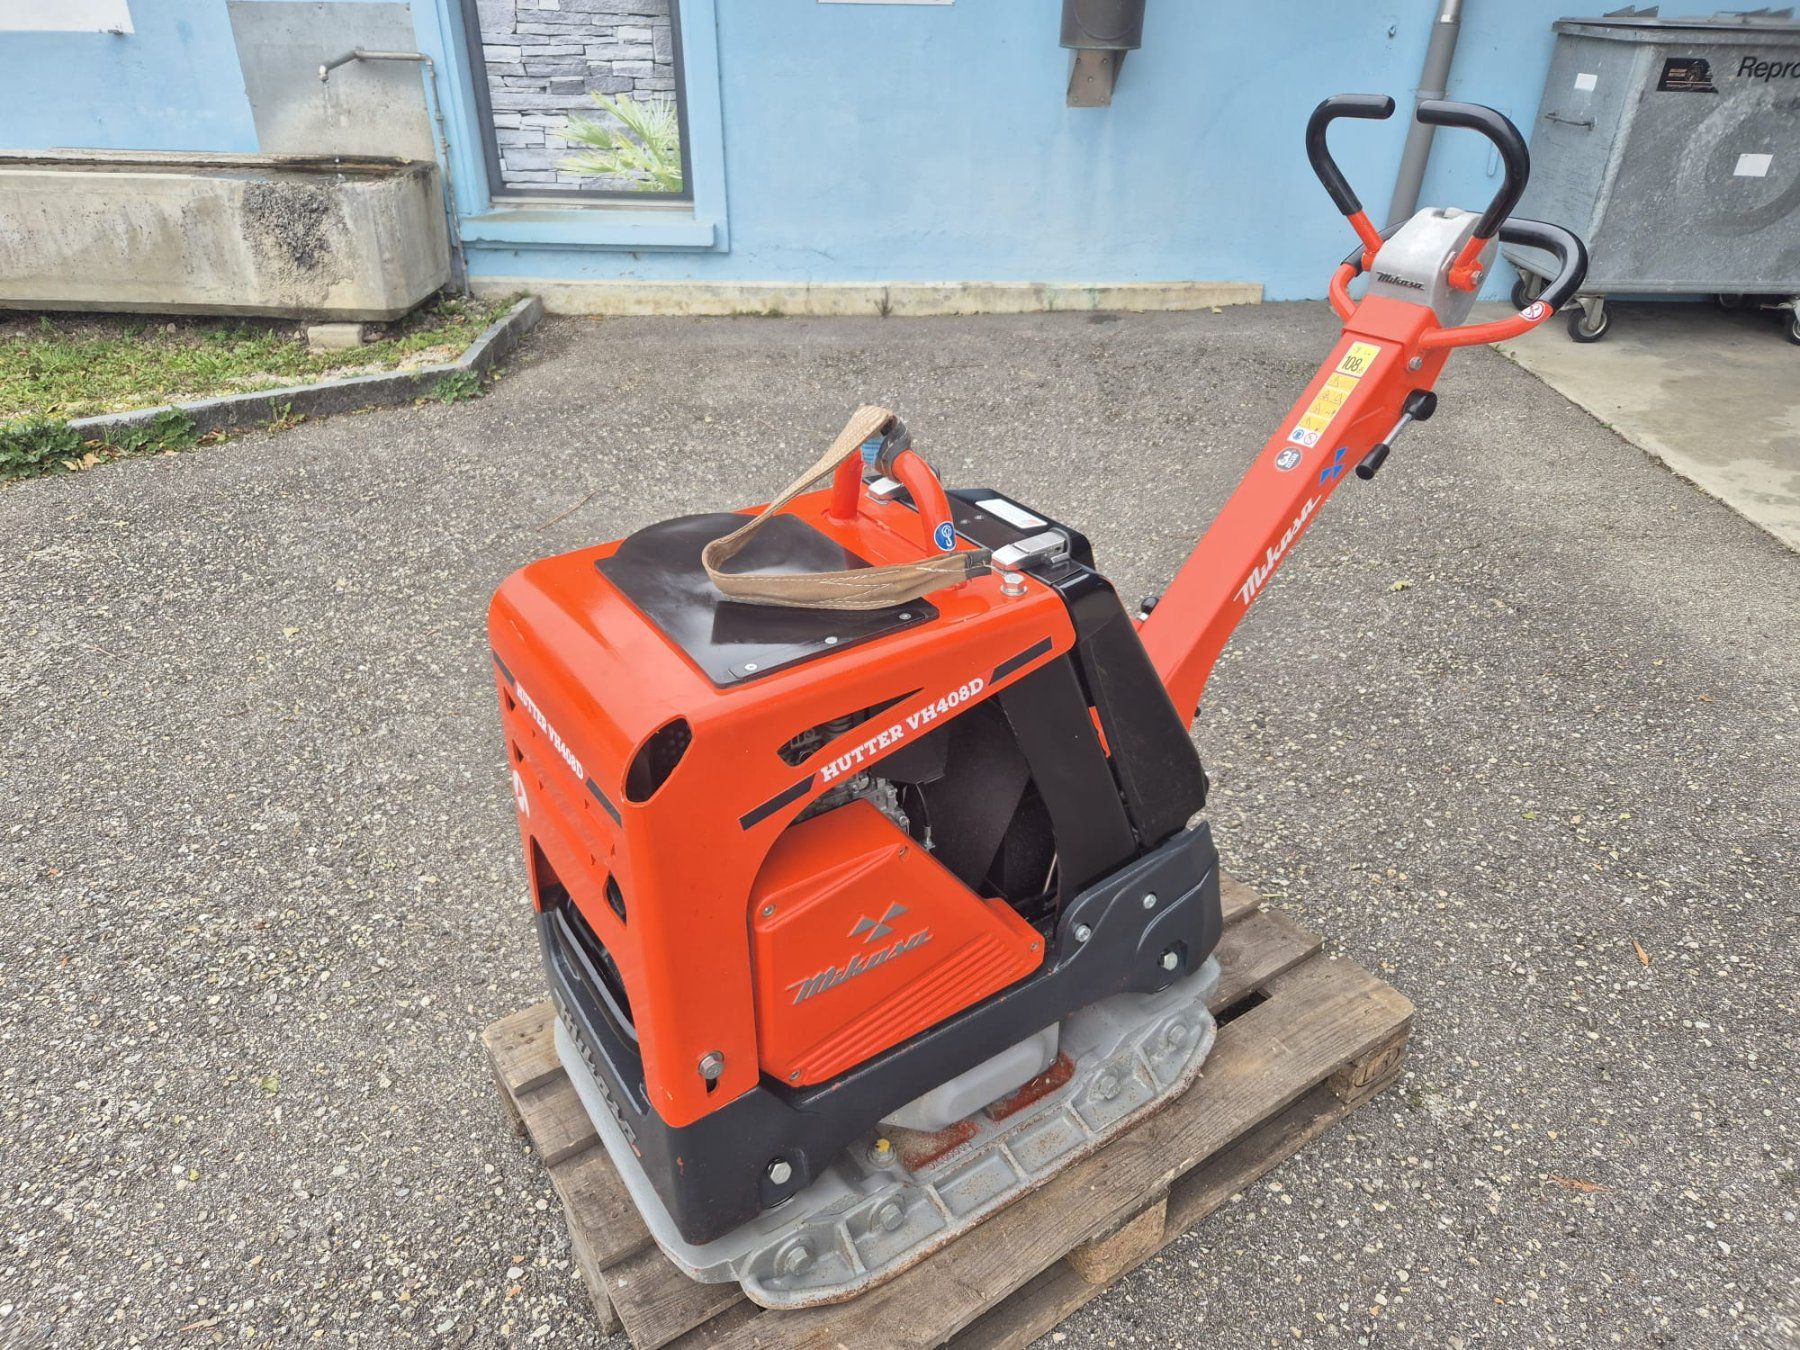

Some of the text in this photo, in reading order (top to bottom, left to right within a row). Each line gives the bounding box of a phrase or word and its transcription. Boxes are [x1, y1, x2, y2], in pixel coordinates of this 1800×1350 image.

[1376, 271, 1425, 291] Mikasa
[1341, 355, 1363, 372] 108
[1232, 494, 1322, 606] Mikasa
[820, 677, 985, 783] HUTTER VH408D
[784, 926, 934, 1007] Mikasa
